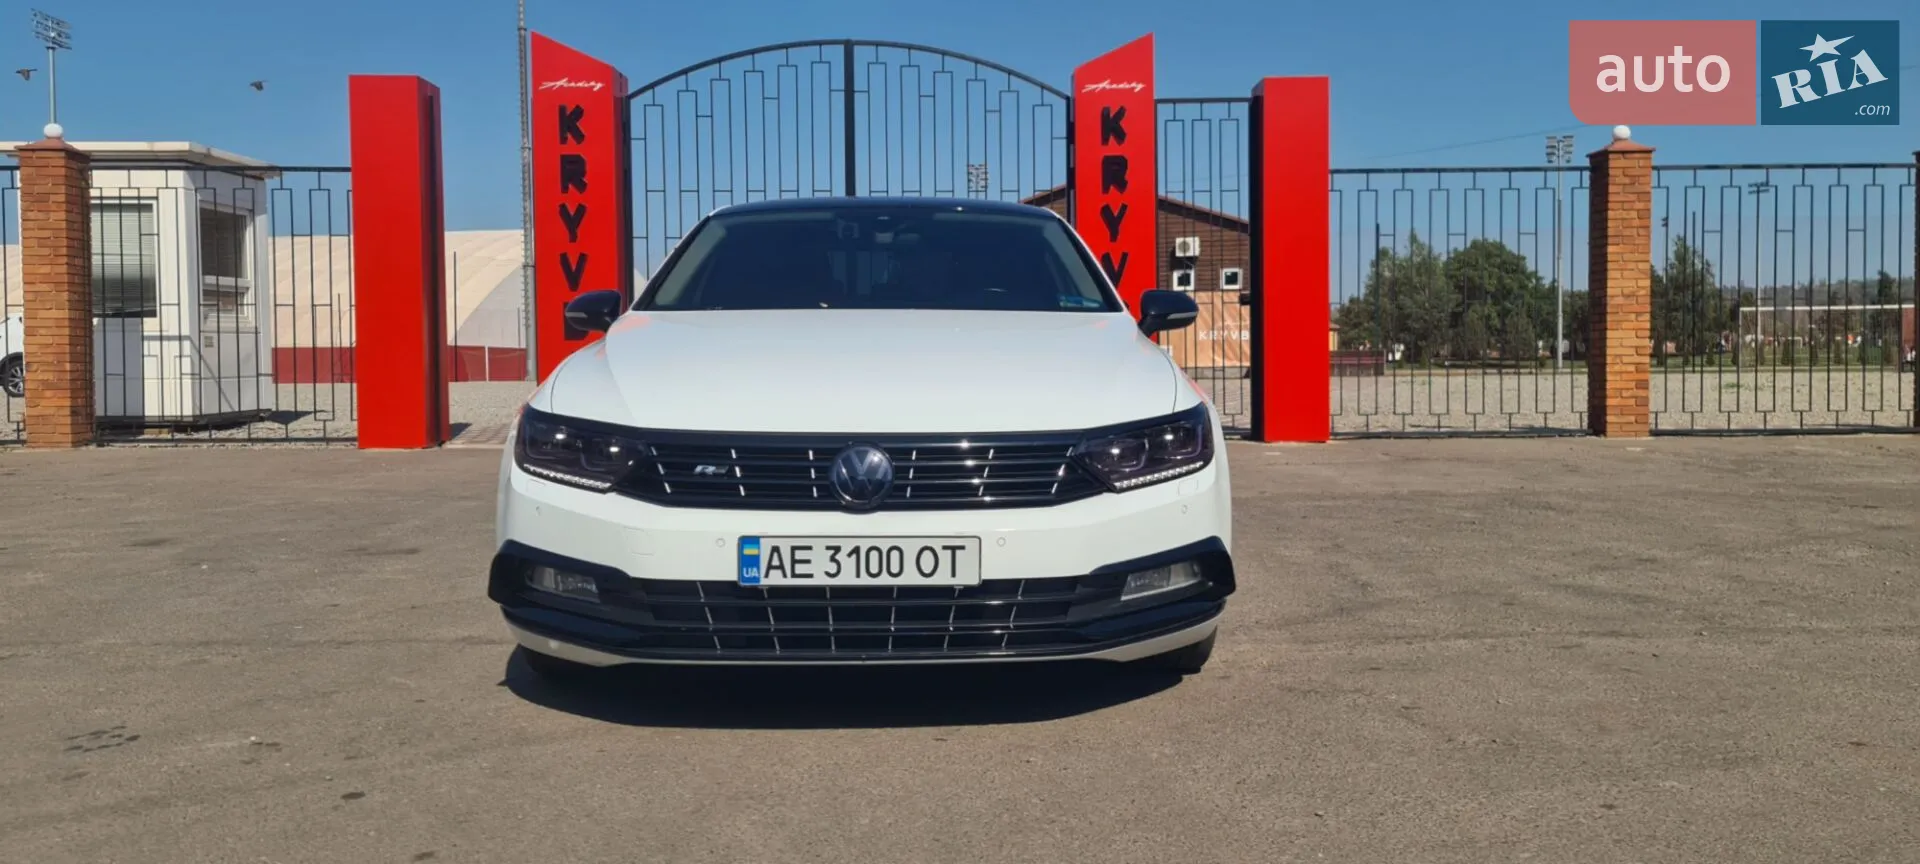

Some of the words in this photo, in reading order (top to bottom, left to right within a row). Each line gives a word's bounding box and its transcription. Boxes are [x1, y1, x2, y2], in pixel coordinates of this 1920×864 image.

[743, 568, 759, 578] UA
[763, 545, 815, 579] AE
[824, 545, 904, 579] 3100
[915, 545, 966, 579] OT
